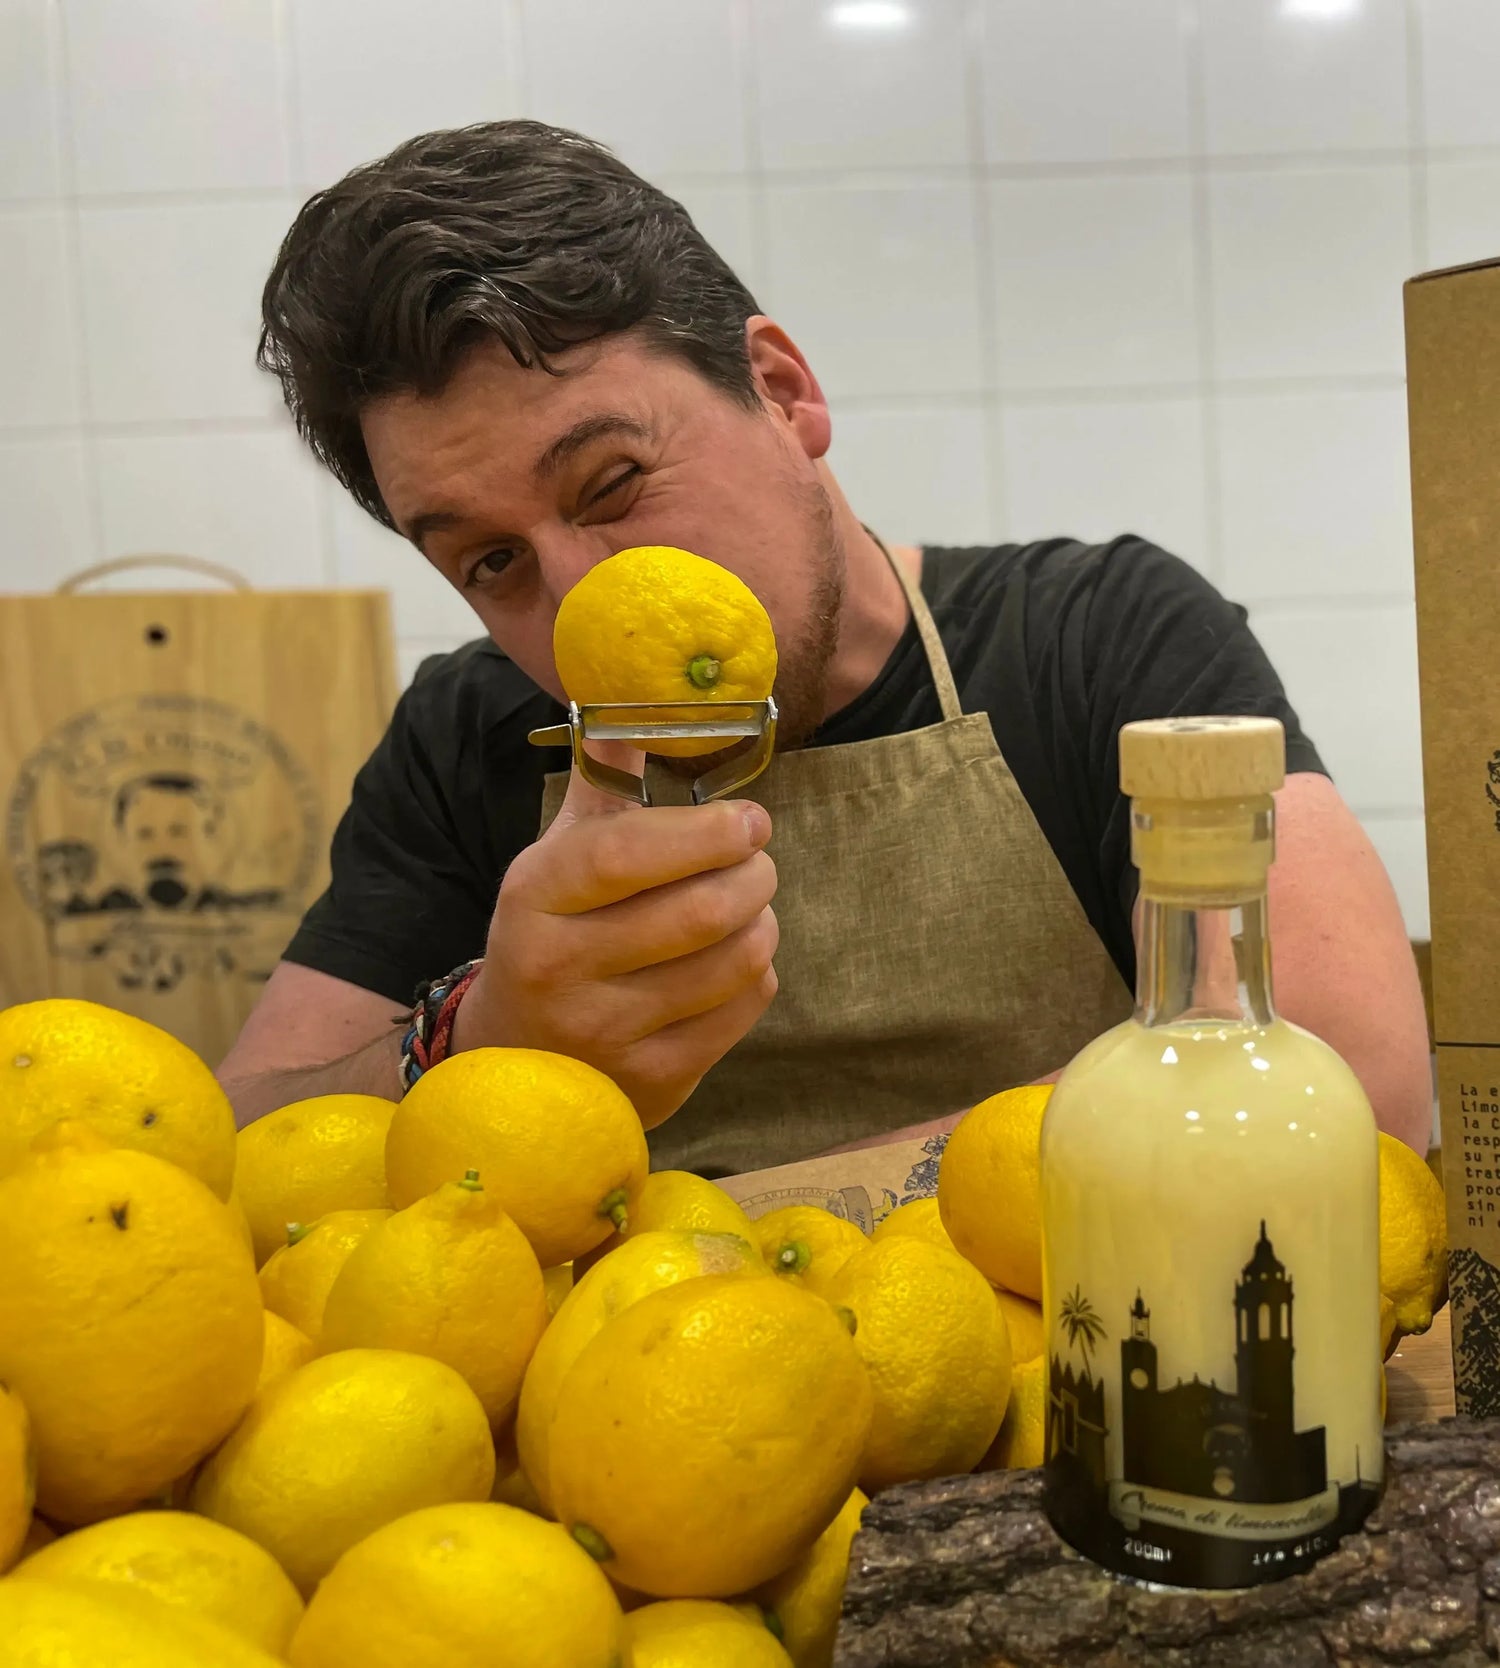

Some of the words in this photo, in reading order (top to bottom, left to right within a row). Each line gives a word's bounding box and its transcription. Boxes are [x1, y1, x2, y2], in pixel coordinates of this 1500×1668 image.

[1461, 1083, 1478, 1096] La
[1461, 1100, 1499, 1113] Limo
[1462, 1116, 1480, 1129] la
[1464, 1151, 1482, 1163] su
[1467, 1199, 1495, 1212] sin
[1468, 1215, 1484, 1228] ni
